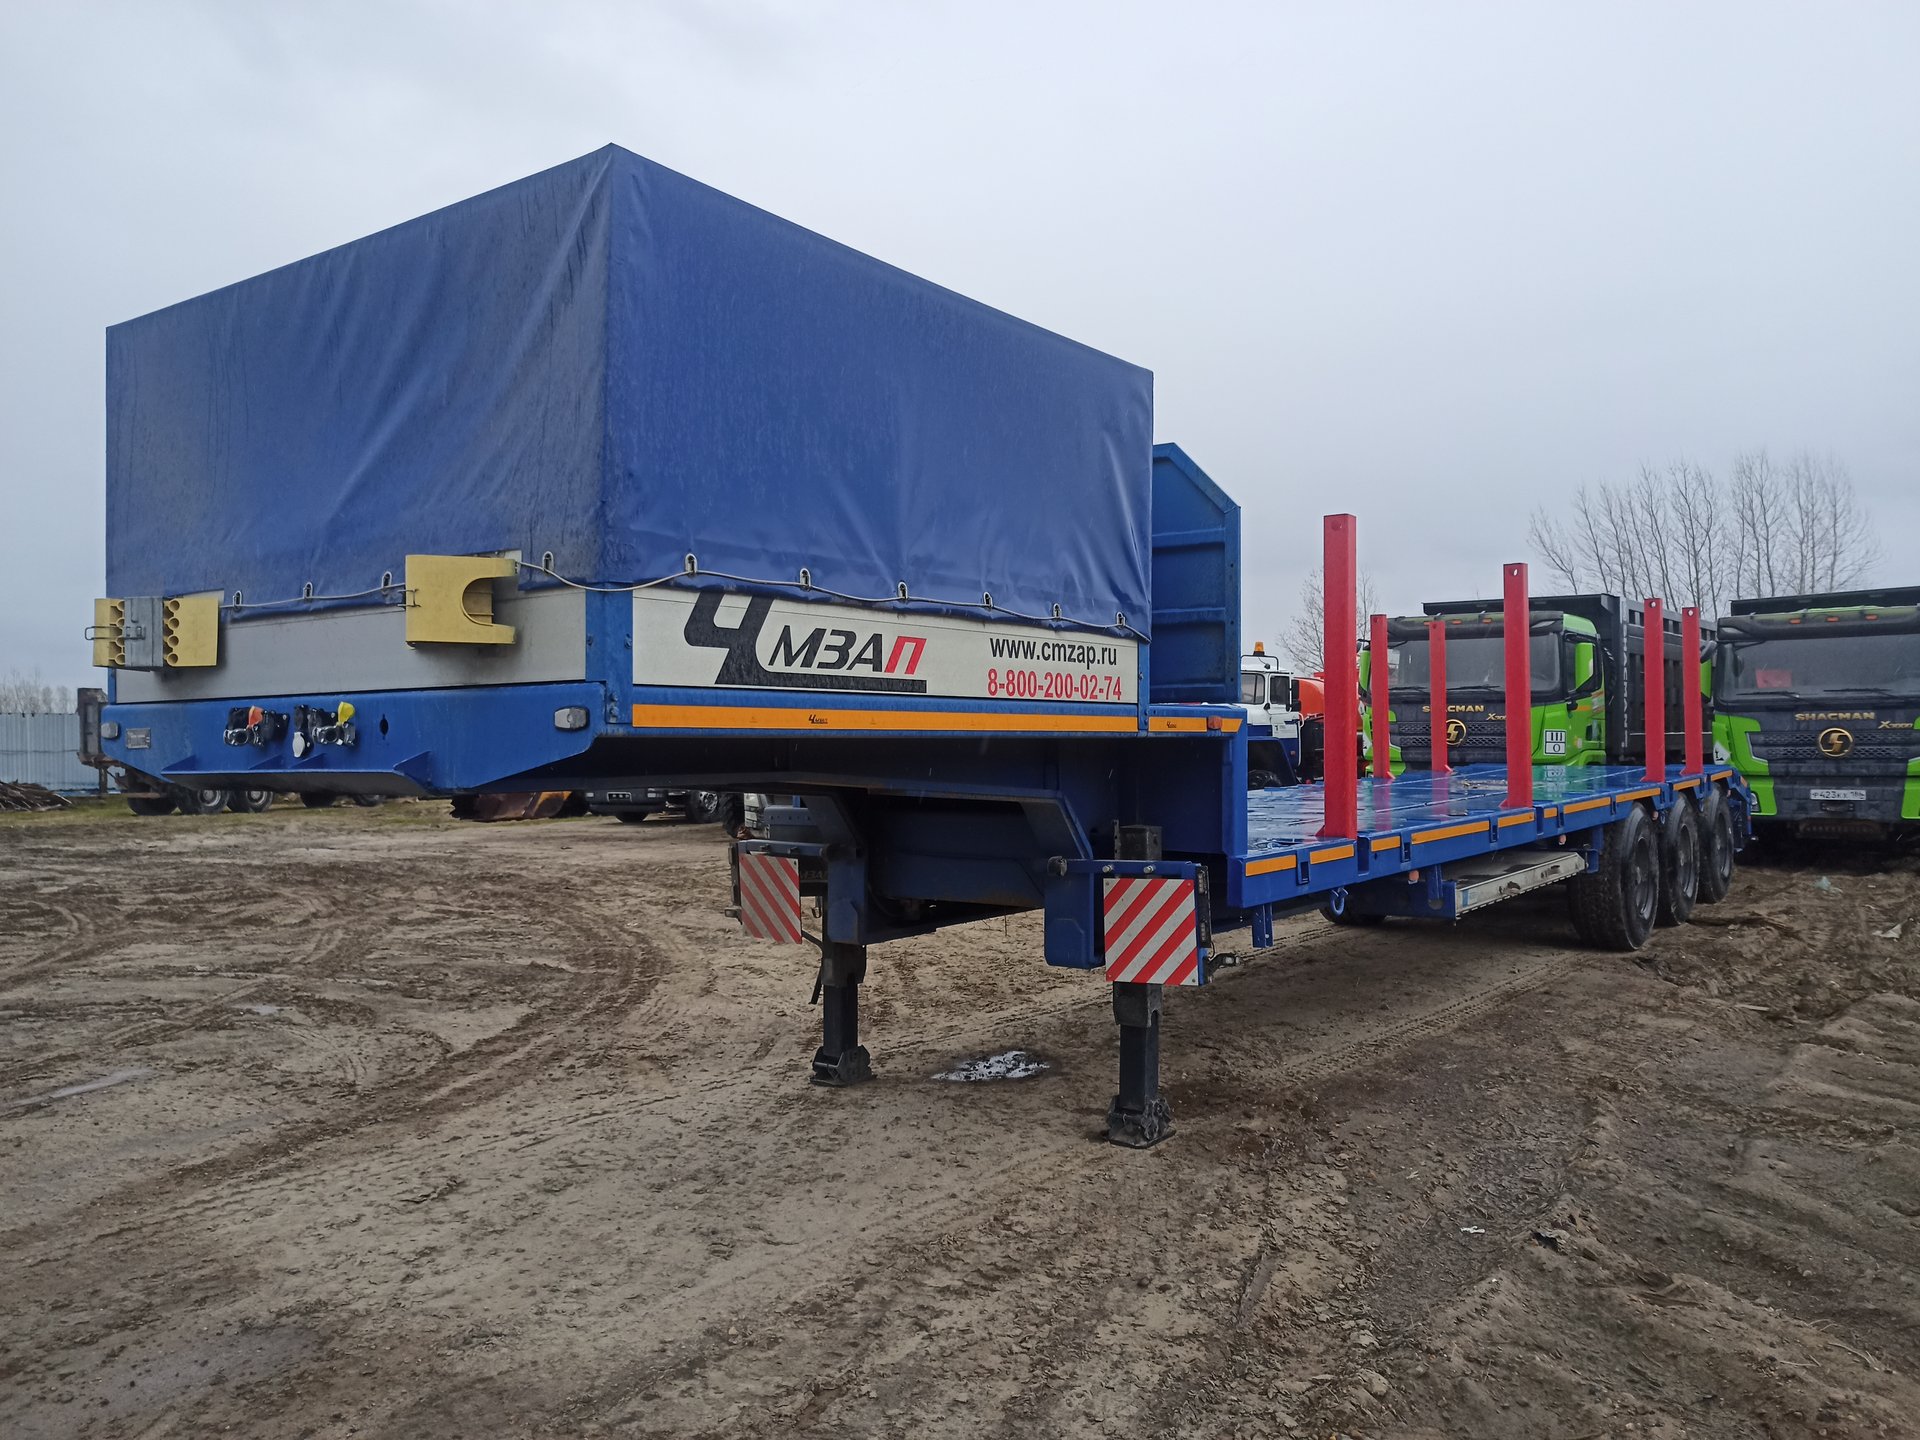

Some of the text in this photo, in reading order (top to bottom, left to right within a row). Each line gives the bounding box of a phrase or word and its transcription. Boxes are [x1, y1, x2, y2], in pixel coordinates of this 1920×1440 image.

[990, 638, 1117, 670] www.cmzap.ru
[988, 668, 1122, 701] 8-800-200-02-74
[1422, 705, 1485, 713] SCMAN
[1794, 711, 1876, 721] SHACMAN
